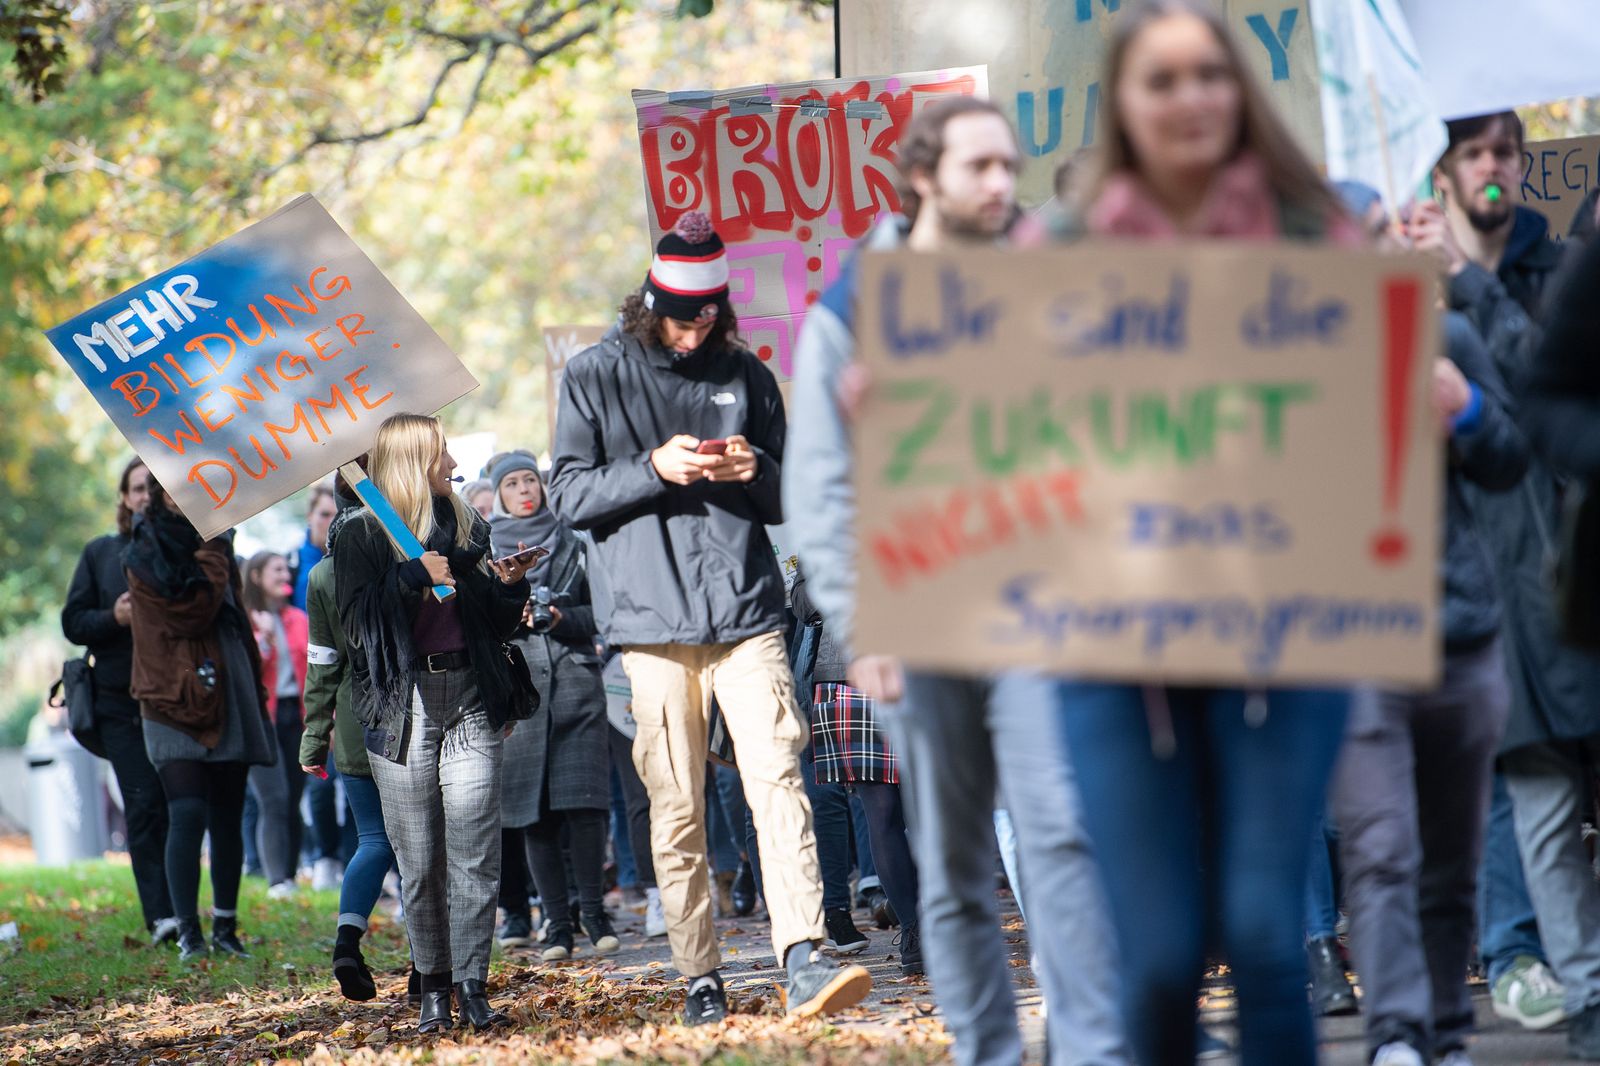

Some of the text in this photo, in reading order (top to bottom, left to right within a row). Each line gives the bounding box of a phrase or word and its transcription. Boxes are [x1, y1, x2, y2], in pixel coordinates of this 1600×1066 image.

[1519, 147, 1600, 202] REG
[73, 274, 217, 373] MEHR
[111, 267, 352, 417] BILDUNG
[879, 264, 1004, 359] Wir
[1240, 264, 1350, 350] die
[148, 313, 375, 455] WENIGER
[188, 365, 394, 510] DUMME
[876, 376, 1320, 487] ZUKUNFT
[868, 468, 1090, 590] NICHT
[984, 571, 1425, 676] Sparprogramm
